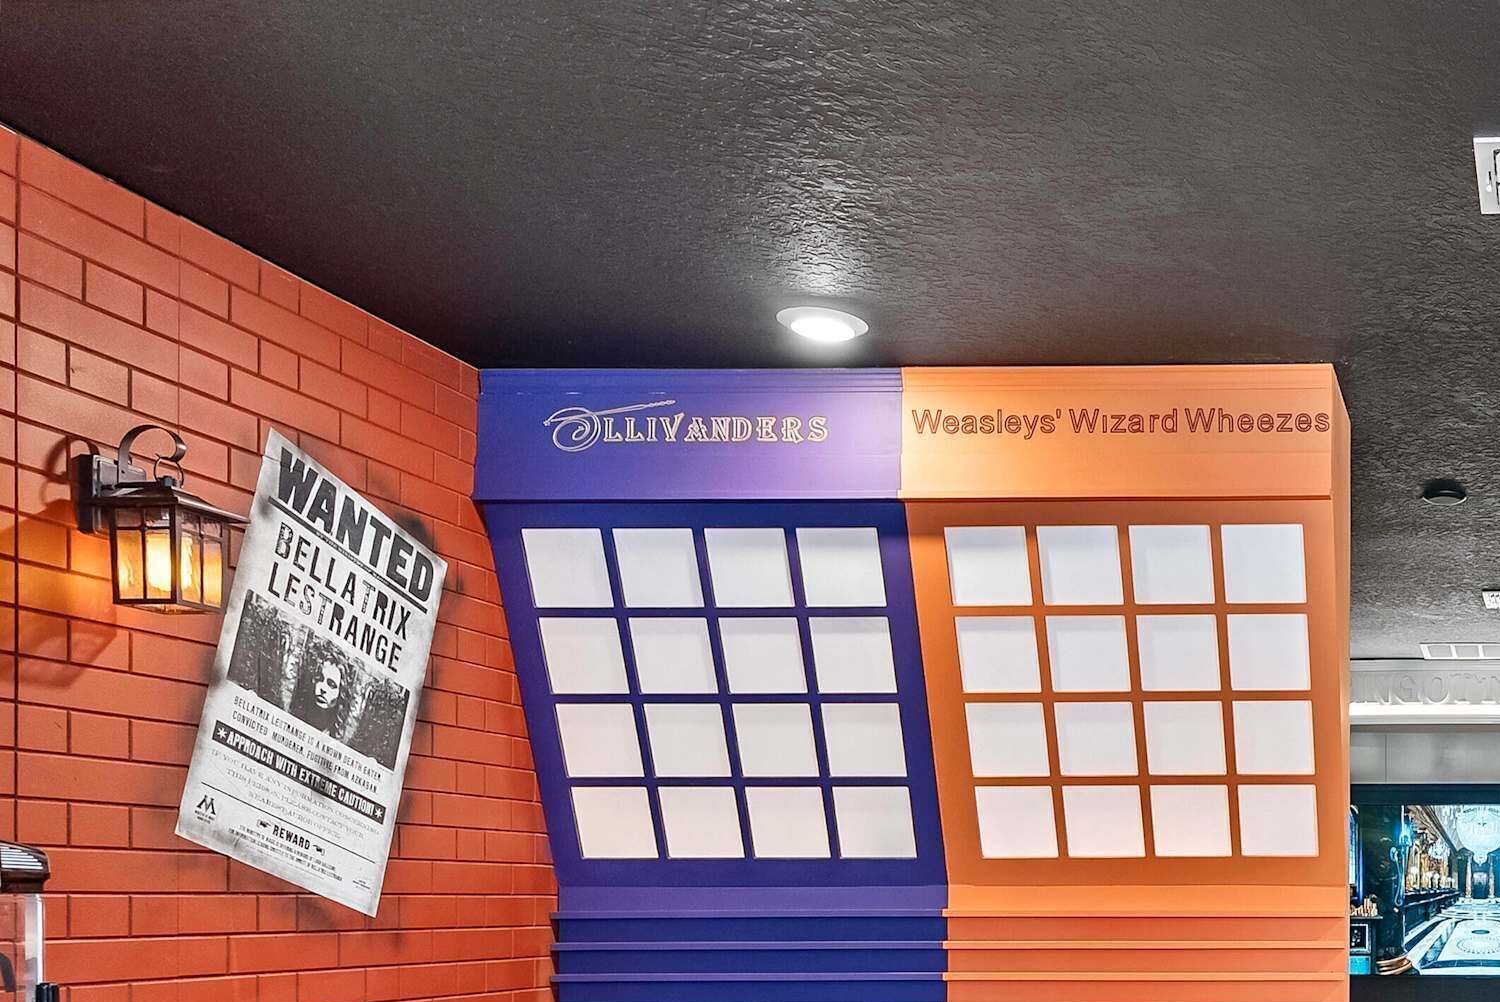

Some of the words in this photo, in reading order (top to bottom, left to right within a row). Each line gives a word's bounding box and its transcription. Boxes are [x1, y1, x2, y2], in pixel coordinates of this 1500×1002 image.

[545, 400, 829, 451] OLLIVANDERS
[912, 409, 1061, 440] Weasleys'
[1069, 408, 1179, 434] Wizard
[1184, 408, 1331, 433] Wheezes
[271, 446, 436, 605] WANTED
[274, 521, 411, 641] BELLATRIX
[267, 561, 402, 673] LESTRANGE
[231, 710, 268, 737] CONVICTED
[233, 695, 269, 722] BELLATRIX
[315, 739, 320, 750] A
[226, 729, 274, 766] APPROACH
[274, 753, 298, 778] WITH
[297, 766, 337, 798] EXTREME
[337, 786, 374, 817] CAUTION!
[272, 824, 311, 851] REWARD
